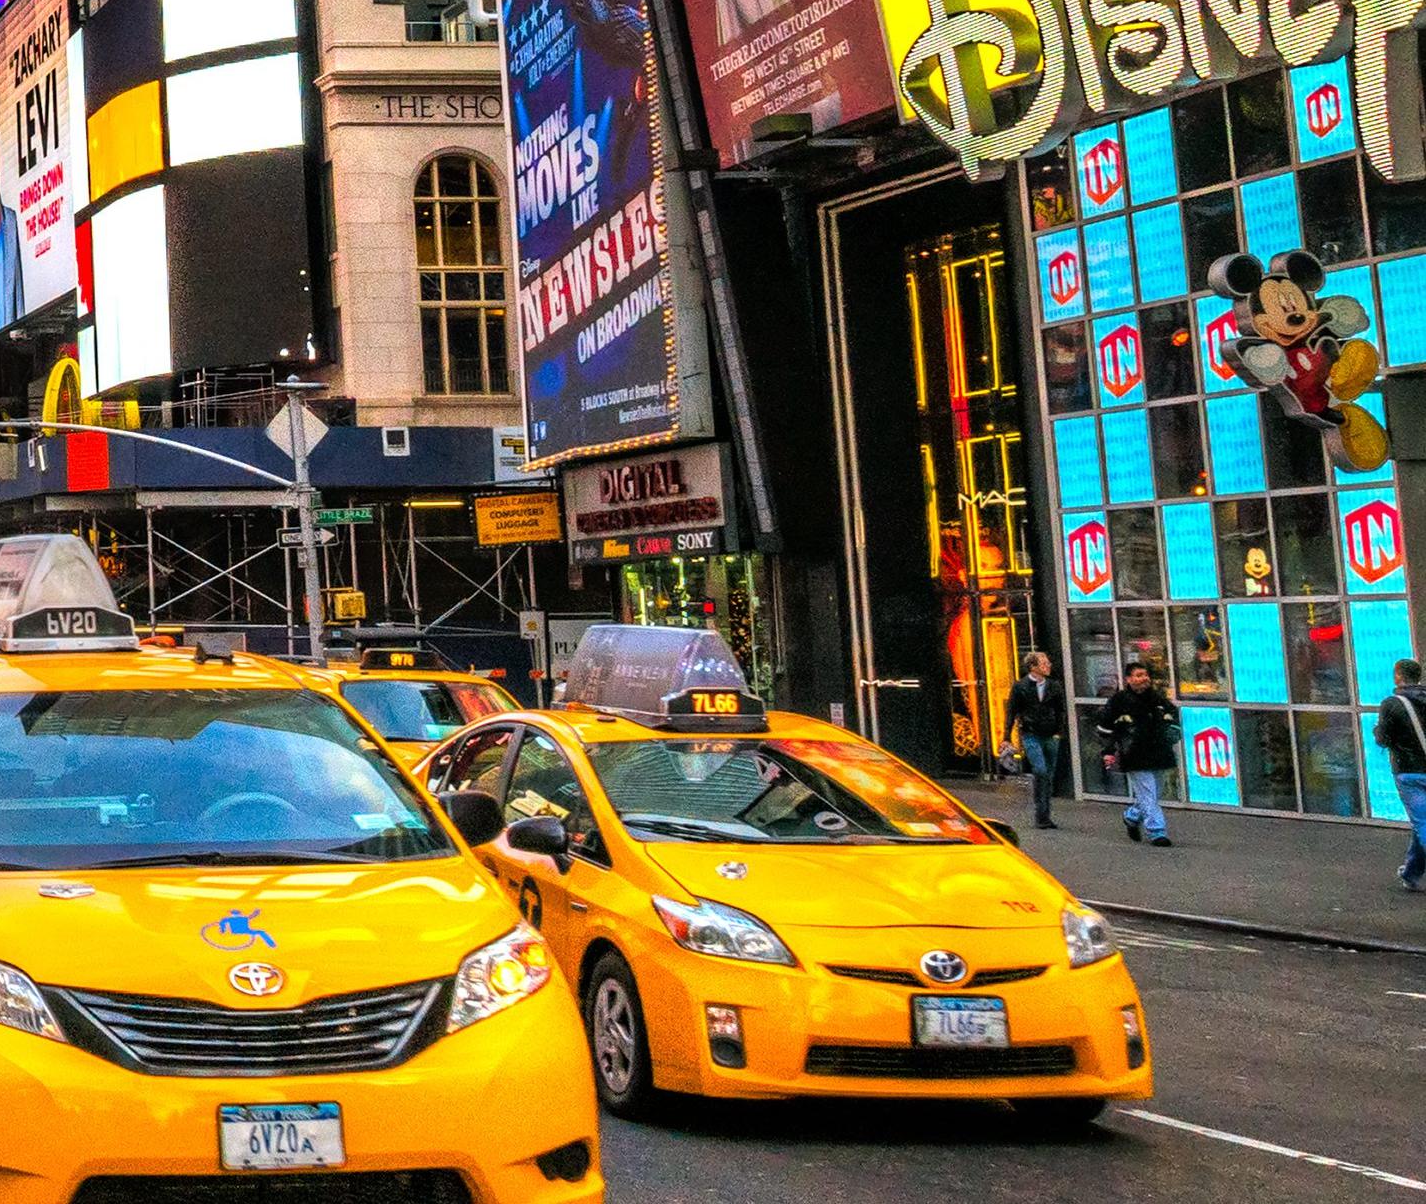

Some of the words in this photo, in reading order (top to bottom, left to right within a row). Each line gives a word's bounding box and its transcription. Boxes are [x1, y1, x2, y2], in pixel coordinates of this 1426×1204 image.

[754, 53, 779, 80] WEST
[793, 27, 827, 59] STREET
[764, 77, 787, 97] TIMES
[785, 60, 817, 86] SQUARE
[15, 67, 60, 178] LEVI
[382, 96, 437, 118] THE
[515, 102, 569, 176] NOTHING
[18, 180, 42, 214] BRINGS
[41, 161, 64, 198] DOWN
[517, 113, 600, 239] MOVES
[571, 181, 600, 232] LIKE
[24, 214, 38, 242] THE
[519, 178, 669, 352] NEWSIES
[576, 325, 597, 365] ON
[599, 459, 687, 504] DIGITAL
[489, 507, 545, 519] COMPUTERS
[496, 518, 540, 529] LUGGAGE
[677, 531, 714, 550] SONY
[45, 608, 98, 635] 6V20
[692, 693, 739, 714] 7L66
